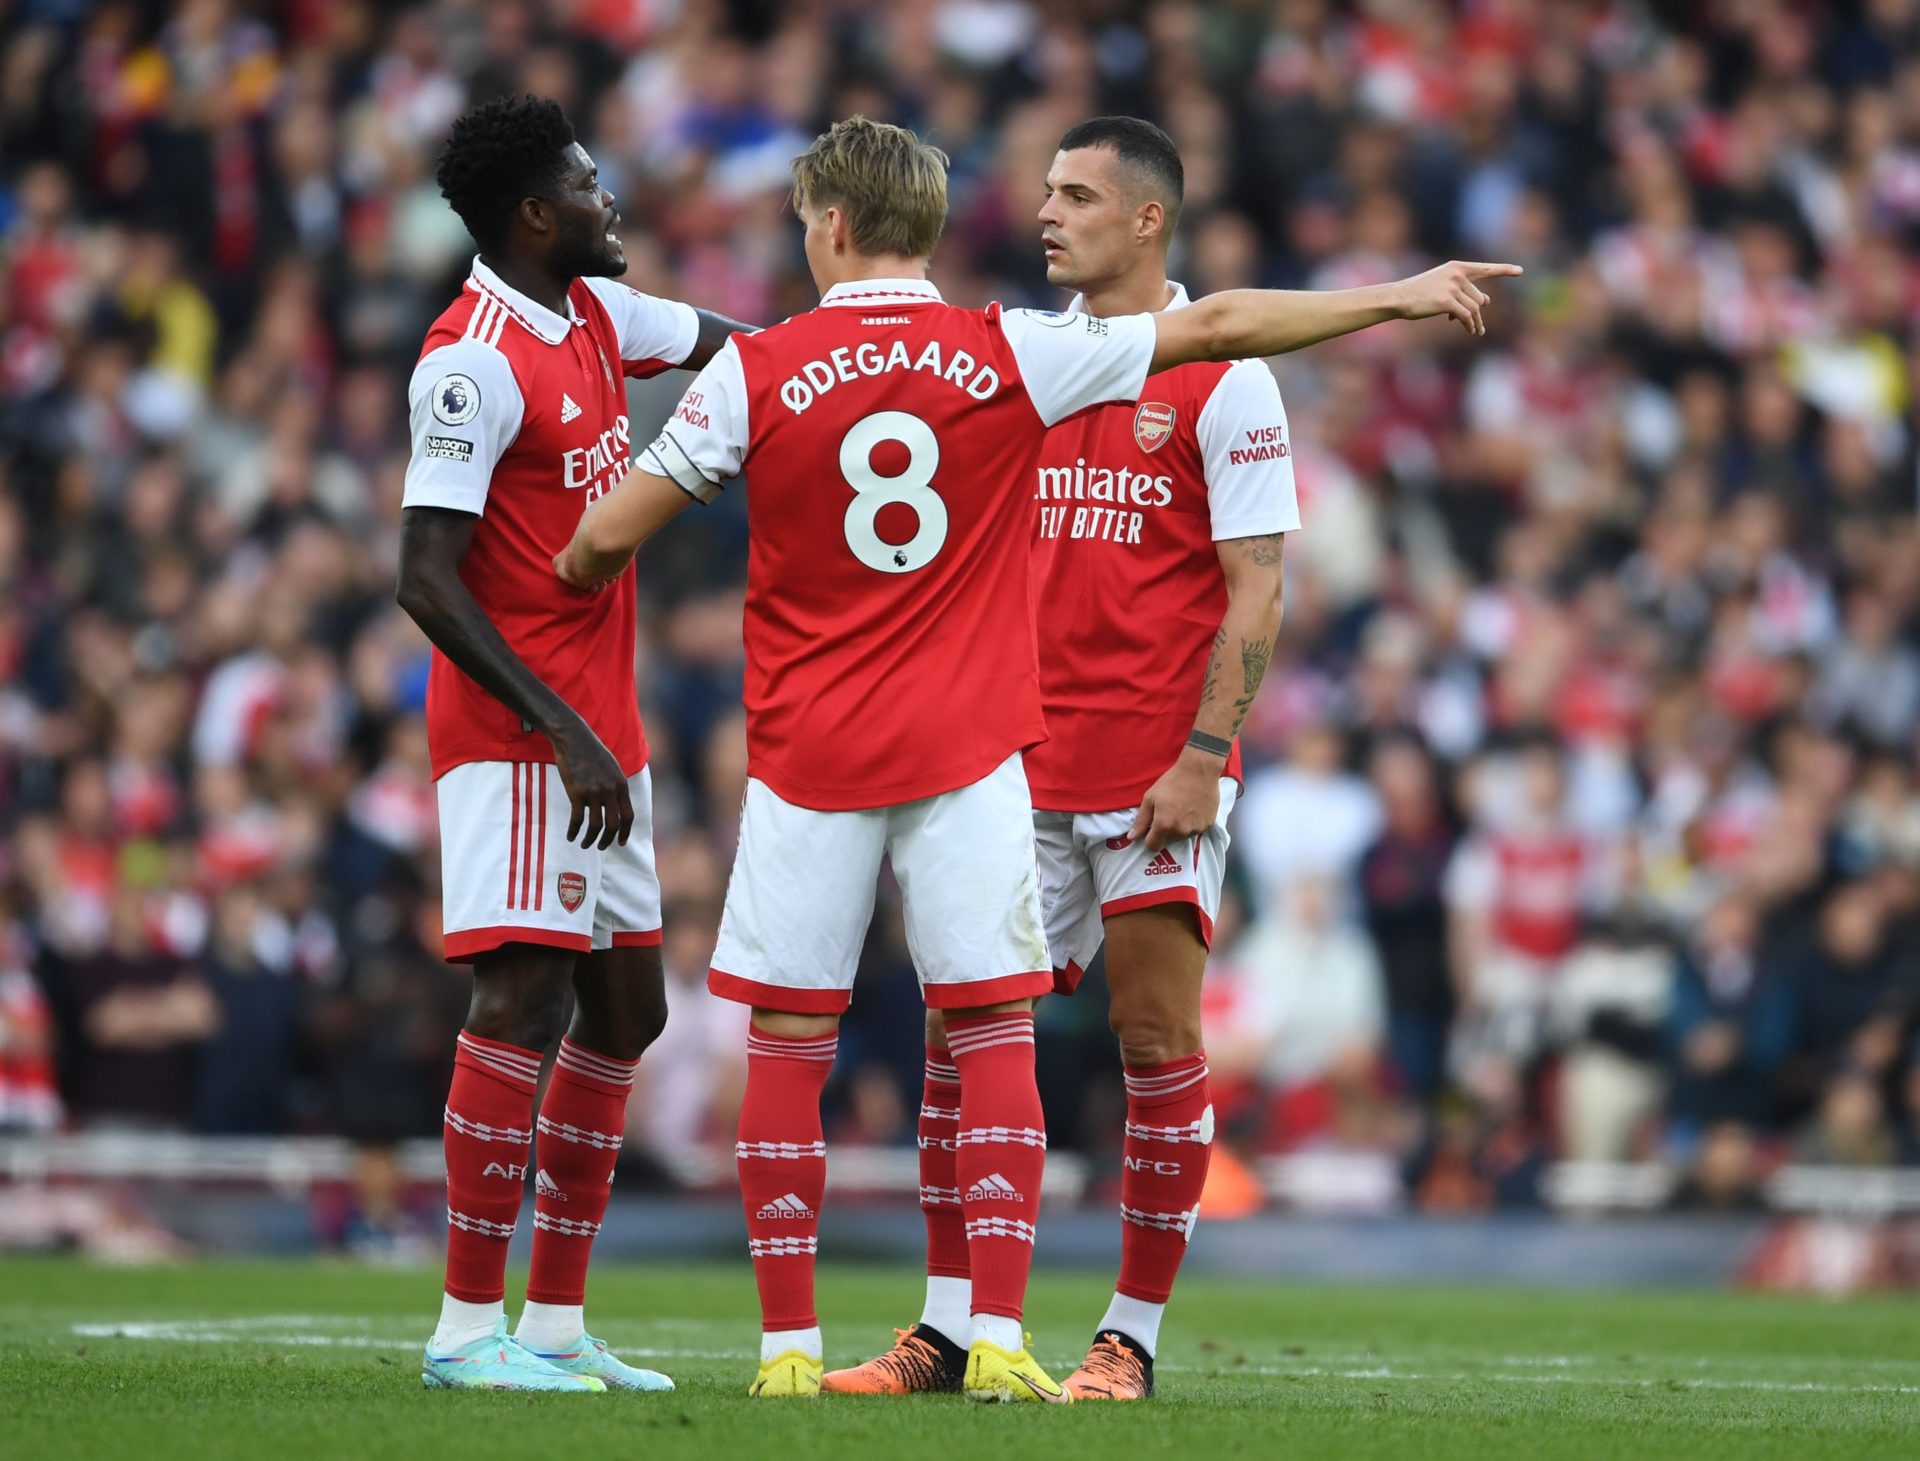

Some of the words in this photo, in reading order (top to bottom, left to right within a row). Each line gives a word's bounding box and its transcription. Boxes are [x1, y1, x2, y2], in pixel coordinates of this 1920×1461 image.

[861, 316, 912, 325] ARSENAL
[780, 340, 999, 415] ØDEGAARD
[1141, 409, 1172, 421] Arsenal
[1246, 425, 1282, 445] VISIT
[839, 410, 948, 573] 8
[1034, 458, 1173, 506] mirates
[1070, 506, 1144, 544] BTTER
[1144, 864, 1182, 876] adidas
[1125, 1155, 1181, 1175] AFC
[965, 1187, 1025, 1202] adidas
[756, 1208, 815, 1220] adidas
